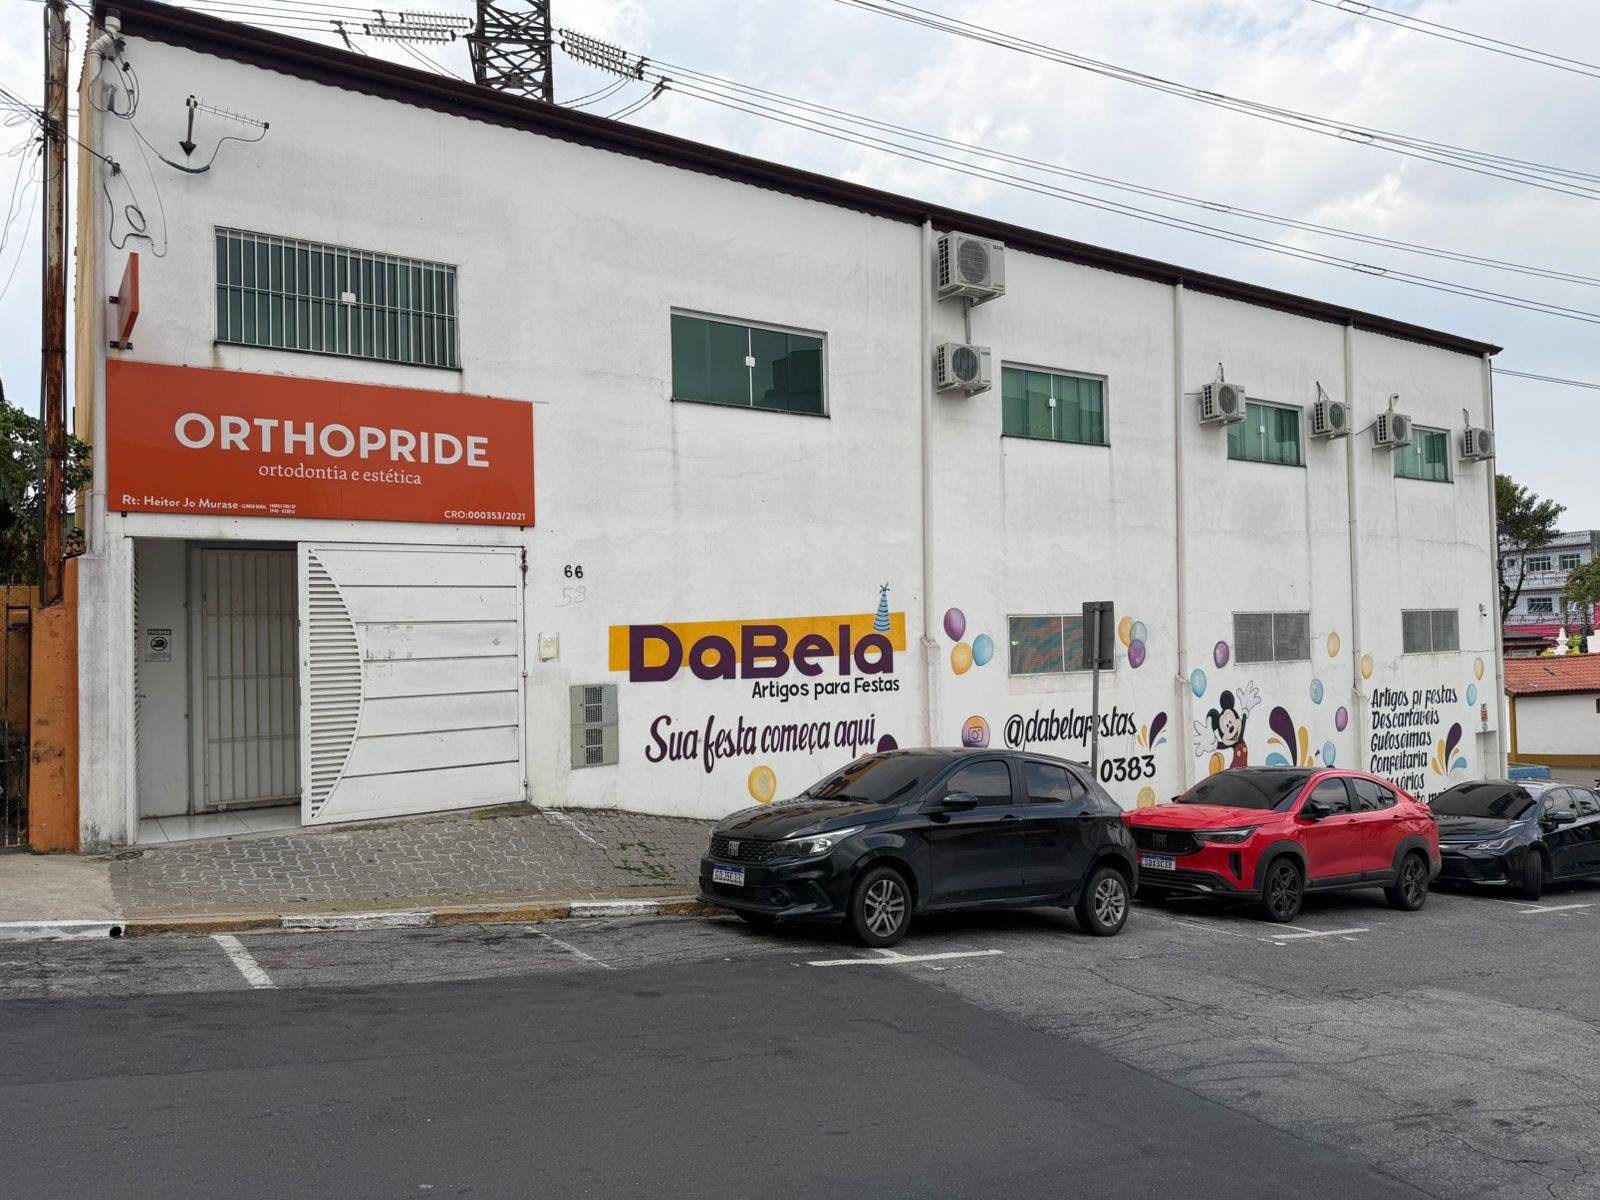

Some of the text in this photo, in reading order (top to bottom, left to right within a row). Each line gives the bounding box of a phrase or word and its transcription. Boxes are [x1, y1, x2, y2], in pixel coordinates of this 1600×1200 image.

[174, 412, 490, 469] ORTHOPRIDE
[258, 462, 422, 486] ortodontia e estética
[122, 494, 140, 506] Rt:
[144, 495, 181, 508] Heitor
[183, 497, 196, 508] Jo
[199, 498, 239, 510] Murase
[444, 510, 526, 521] CRO:000353/2021
[564, 564, 584, 579] 66
[629, 624, 894, 683] DaBela
[752, 677, 900, 702] Artigos para Festas
[1371, 687, 1409, 712] Artigos
[1371, 707, 1440, 730] Descartáveis
[645, 713, 876, 774] Sua festa começa aqui
[1370, 730, 1432, 752] Guloseimas
[1100, 754, 1157, 783] 0383
[1370, 750, 1428, 775] Confeitaria
